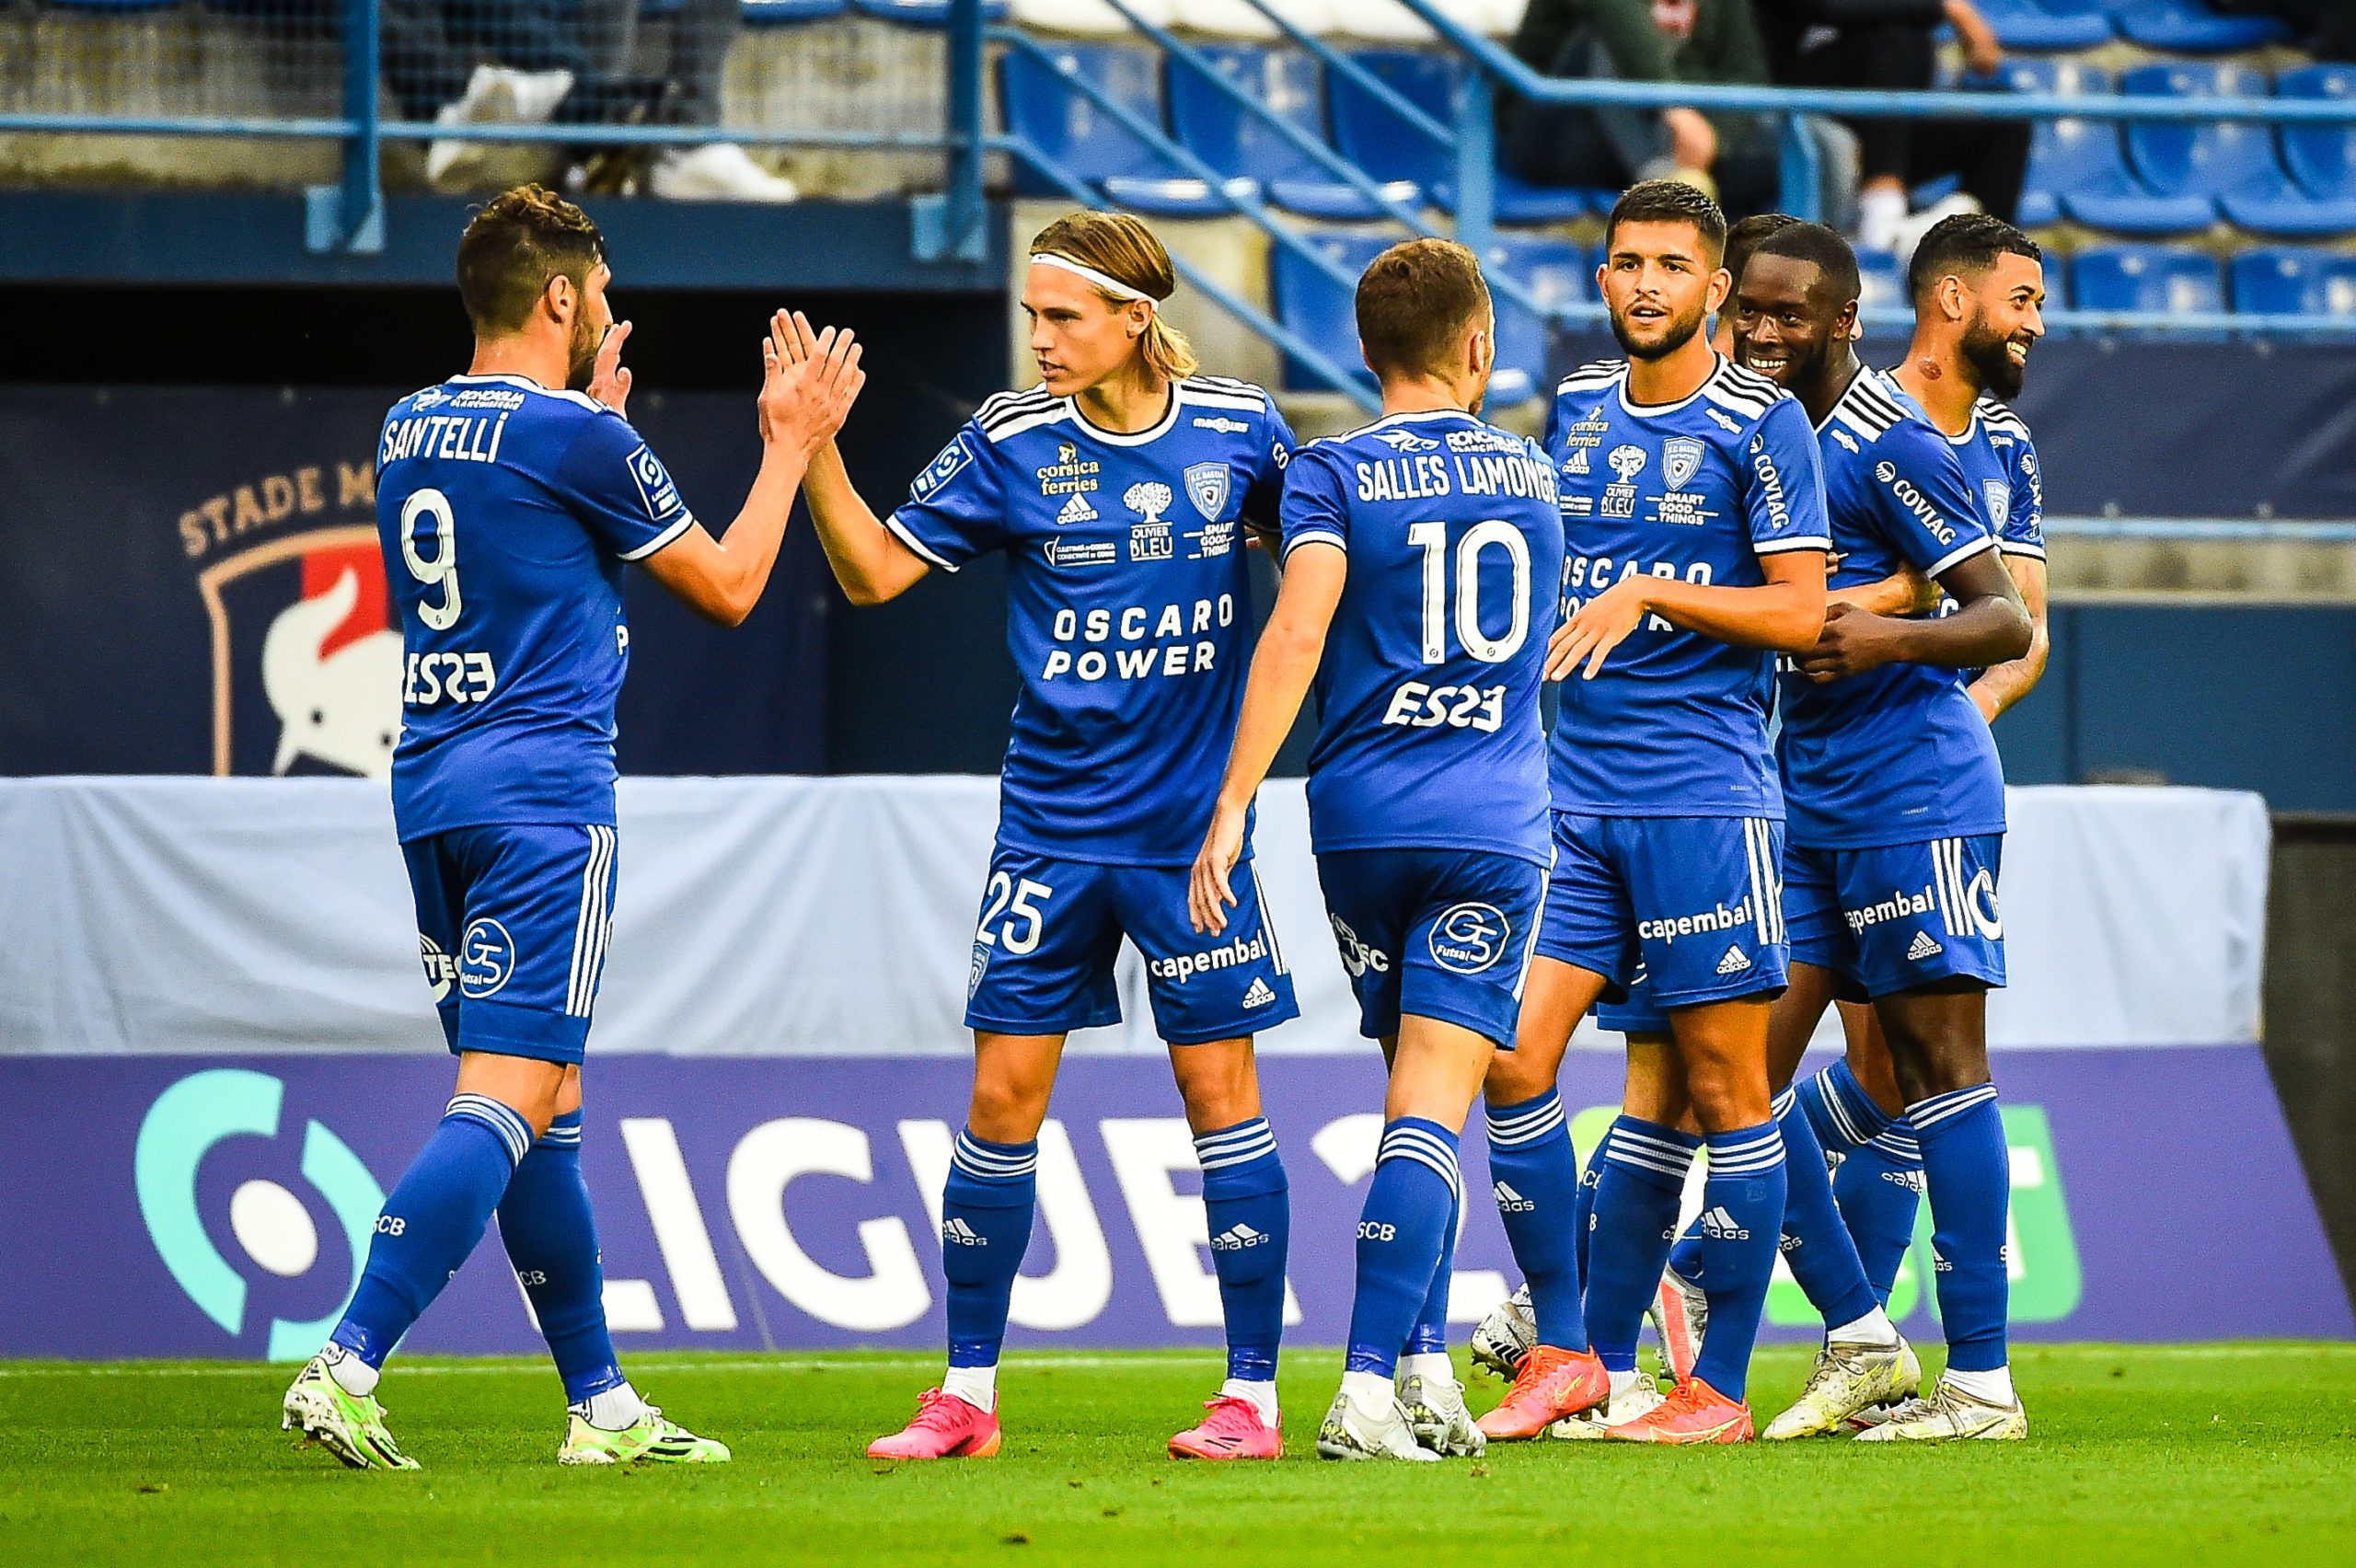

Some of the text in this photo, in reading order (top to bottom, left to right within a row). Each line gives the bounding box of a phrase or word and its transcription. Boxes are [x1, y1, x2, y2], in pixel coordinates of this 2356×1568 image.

[1570, 417, 1610, 432] corsica
[382, 411, 509, 464] SANTELLI
[1566, 431, 1602, 447] ferries
[1036, 459, 1100, 479] corsica
[1562, 463, 1590, 475] adidas
[1042, 476, 1098, 496] ferries
[1356, 455, 1558, 505] SALLES LAMONGE
[1605, 487, 1634, 498] OLIVIER
[1664, 492, 1705, 505] SMART
[1754, 454, 1790, 530] COVIAG
[178, 465, 325, 559] STADE
[1600, 497, 1635, 514] BLEU
[1658, 502, 1693, 513] GOOD
[1892, 479, 1957, 546] COVIAG
[1057, 510, 1099, 525] adidas
[1659, 512, 1704, 525] THINGS
[1131, 525, 1169, 539] OLIVIER
[1205, 521, 1235, 536] SMART
[1129, 536, 1173, 558] BLEU
[1200, 534, 1227, 546] GOOD
[401, 488, 461, 631] 9
[1201, 543, 1230, 558] THINGS
[1406, 519, 1531, 664] 10
[1053, 593, 1233, 642] OSCARO
[1042, 640, 1216, 681] POWER
[976, 870, 1053, 954] 25
[1638, 894, 1753, 945] capembal
[1843, 884, 1935, 935] apembal
[1150, 928, 1268, 984] capembal
[1436, 944, 1471, 962] Futsal
[1907, 943, 1943, 961] adidas
[1242, 990, 1276, 1009] adidas
[1356, 1221, 1396, 1242] SCB
